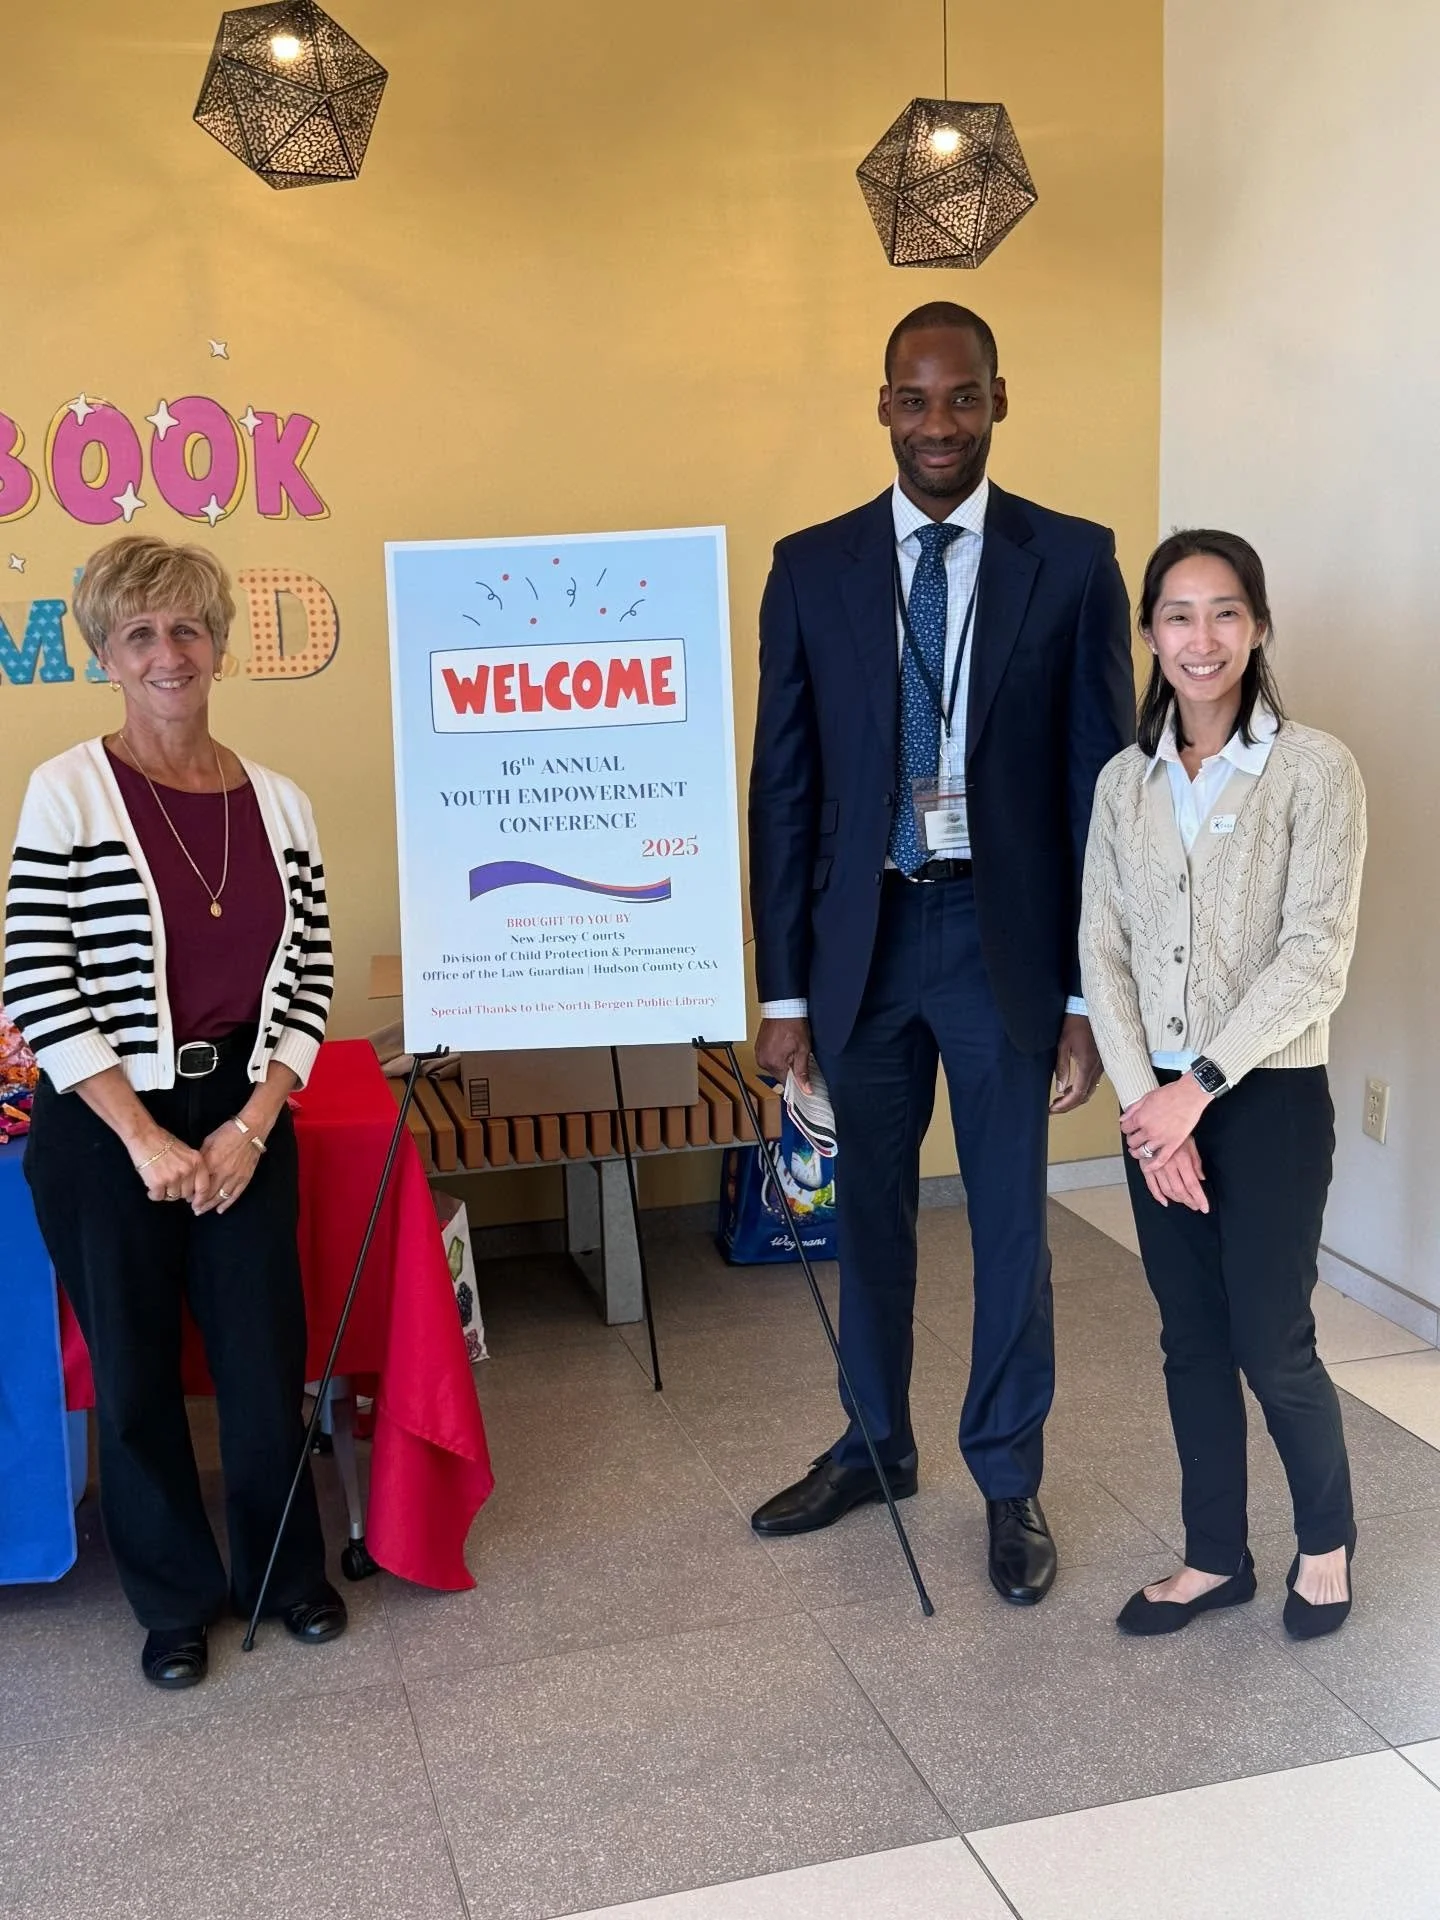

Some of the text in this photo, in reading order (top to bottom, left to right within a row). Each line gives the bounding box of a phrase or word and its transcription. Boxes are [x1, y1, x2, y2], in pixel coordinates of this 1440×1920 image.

[441, 656, 676, 715] WELCOME
[501, 755, 624, 776] 16th ANNUAL
[440, 781, 687, 807] YOUTH EMPOWERMENT
[499, 812, 637, 833] CONFERENCE
[642, 836, 699, 858] 2025
[506, 913, 630, 928] BROUGHT TO YOU BY
[511, 935, 534, 944] New
[538, 933, 577, 944] Jersey
[442, 945, 697, 964] Division of Child Protection & Permanency
[422, 970, 459, 981] Office
[462, 969, 476, 979] of
[478, 968, 498, 979] the
[502, 968, 524, 978] Law
[528, 965, 584, 977] Guardian
[594, 963, 639, 974] Hudson
[642, 962, 683, 972] County
[688, 960, 718, 970] CASA
[431, 996, 716, 1018] Special Thanks to the North Bergen Public Library
